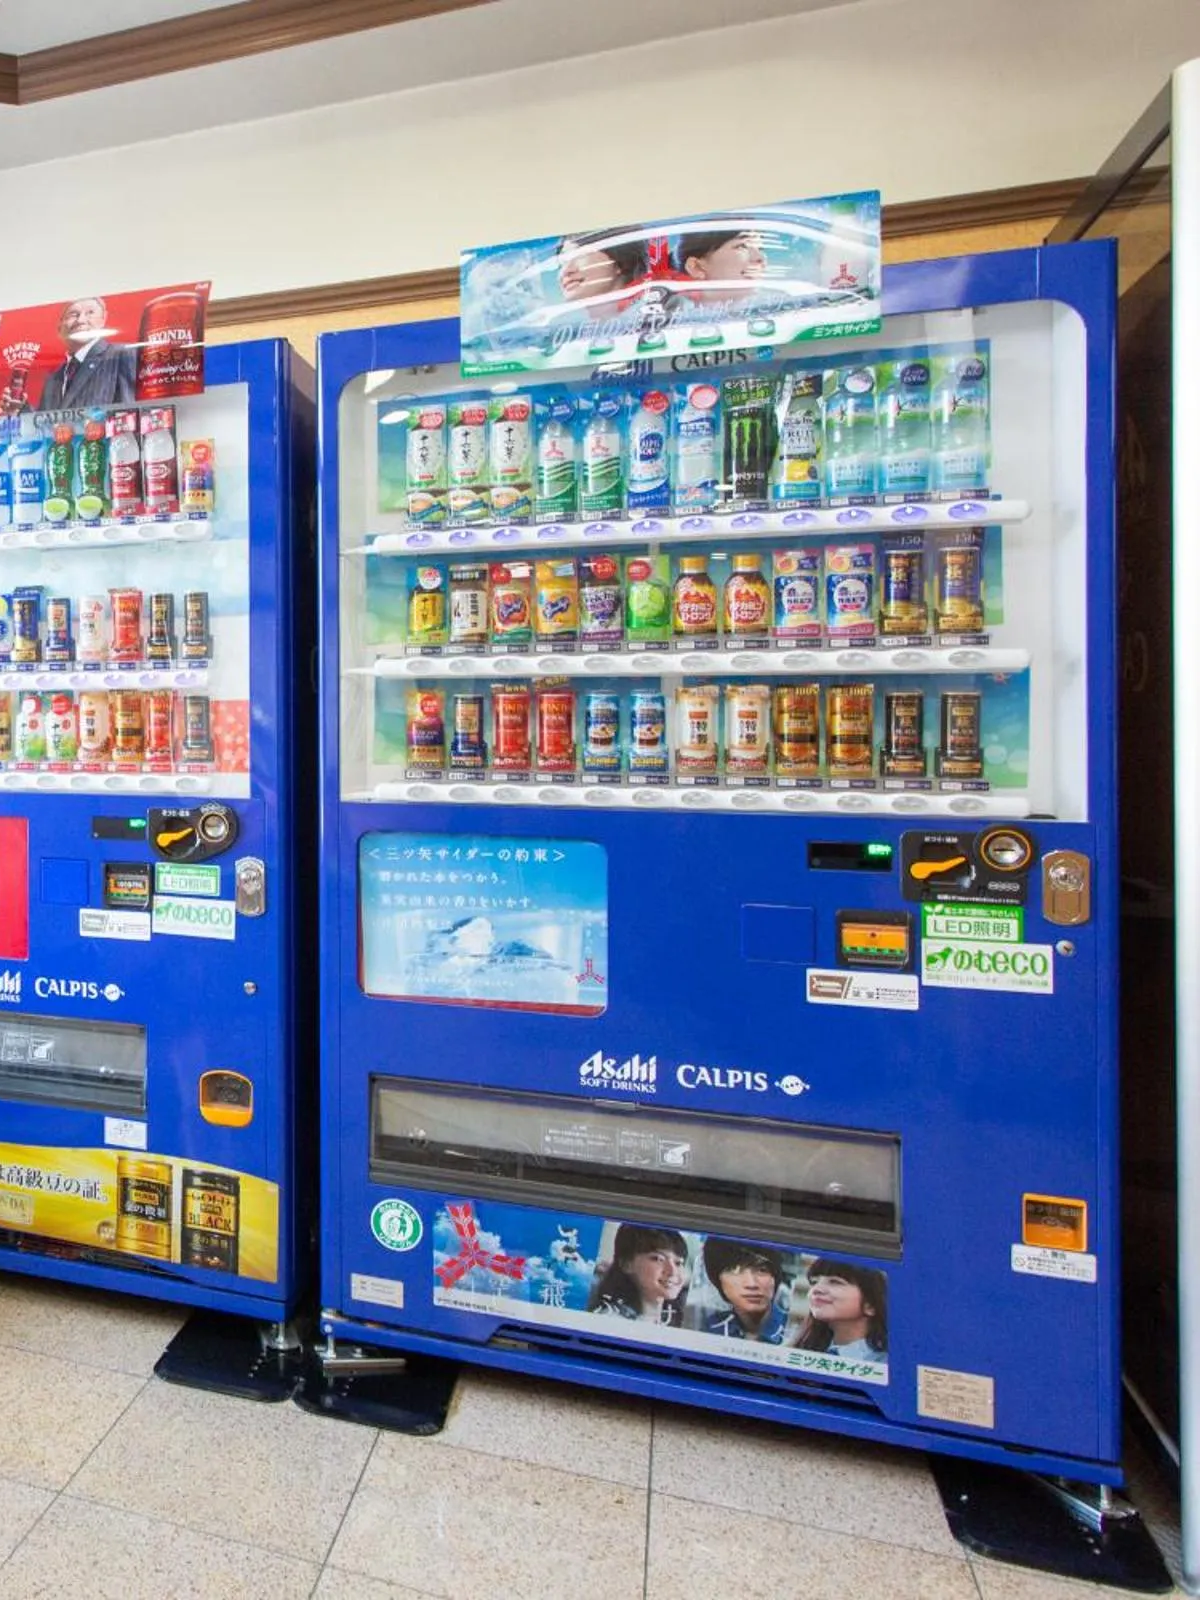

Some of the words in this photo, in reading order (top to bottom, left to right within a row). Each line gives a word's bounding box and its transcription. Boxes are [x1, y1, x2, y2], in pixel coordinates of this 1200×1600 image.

[671, 348, 748, 373] CALPIS
[33, 409, 85, 428] CALPIS
[932, 918, 1011, 938] LED照明
[952, 948, 1048, 976] のむeco
[35, 977, 99, 999] CALPIS
[579, 1050, 658, 1084] Asahi
[676, 1064, 769, 1092] CALPIS
[580, 1076, 610, 1090] SOFT
[612, 1079, 657, 1094] DRINKS
[188, 1213, 232, 1232] BLACK
[787, 1352, 885, 1380] 三ツ矢サイダー
